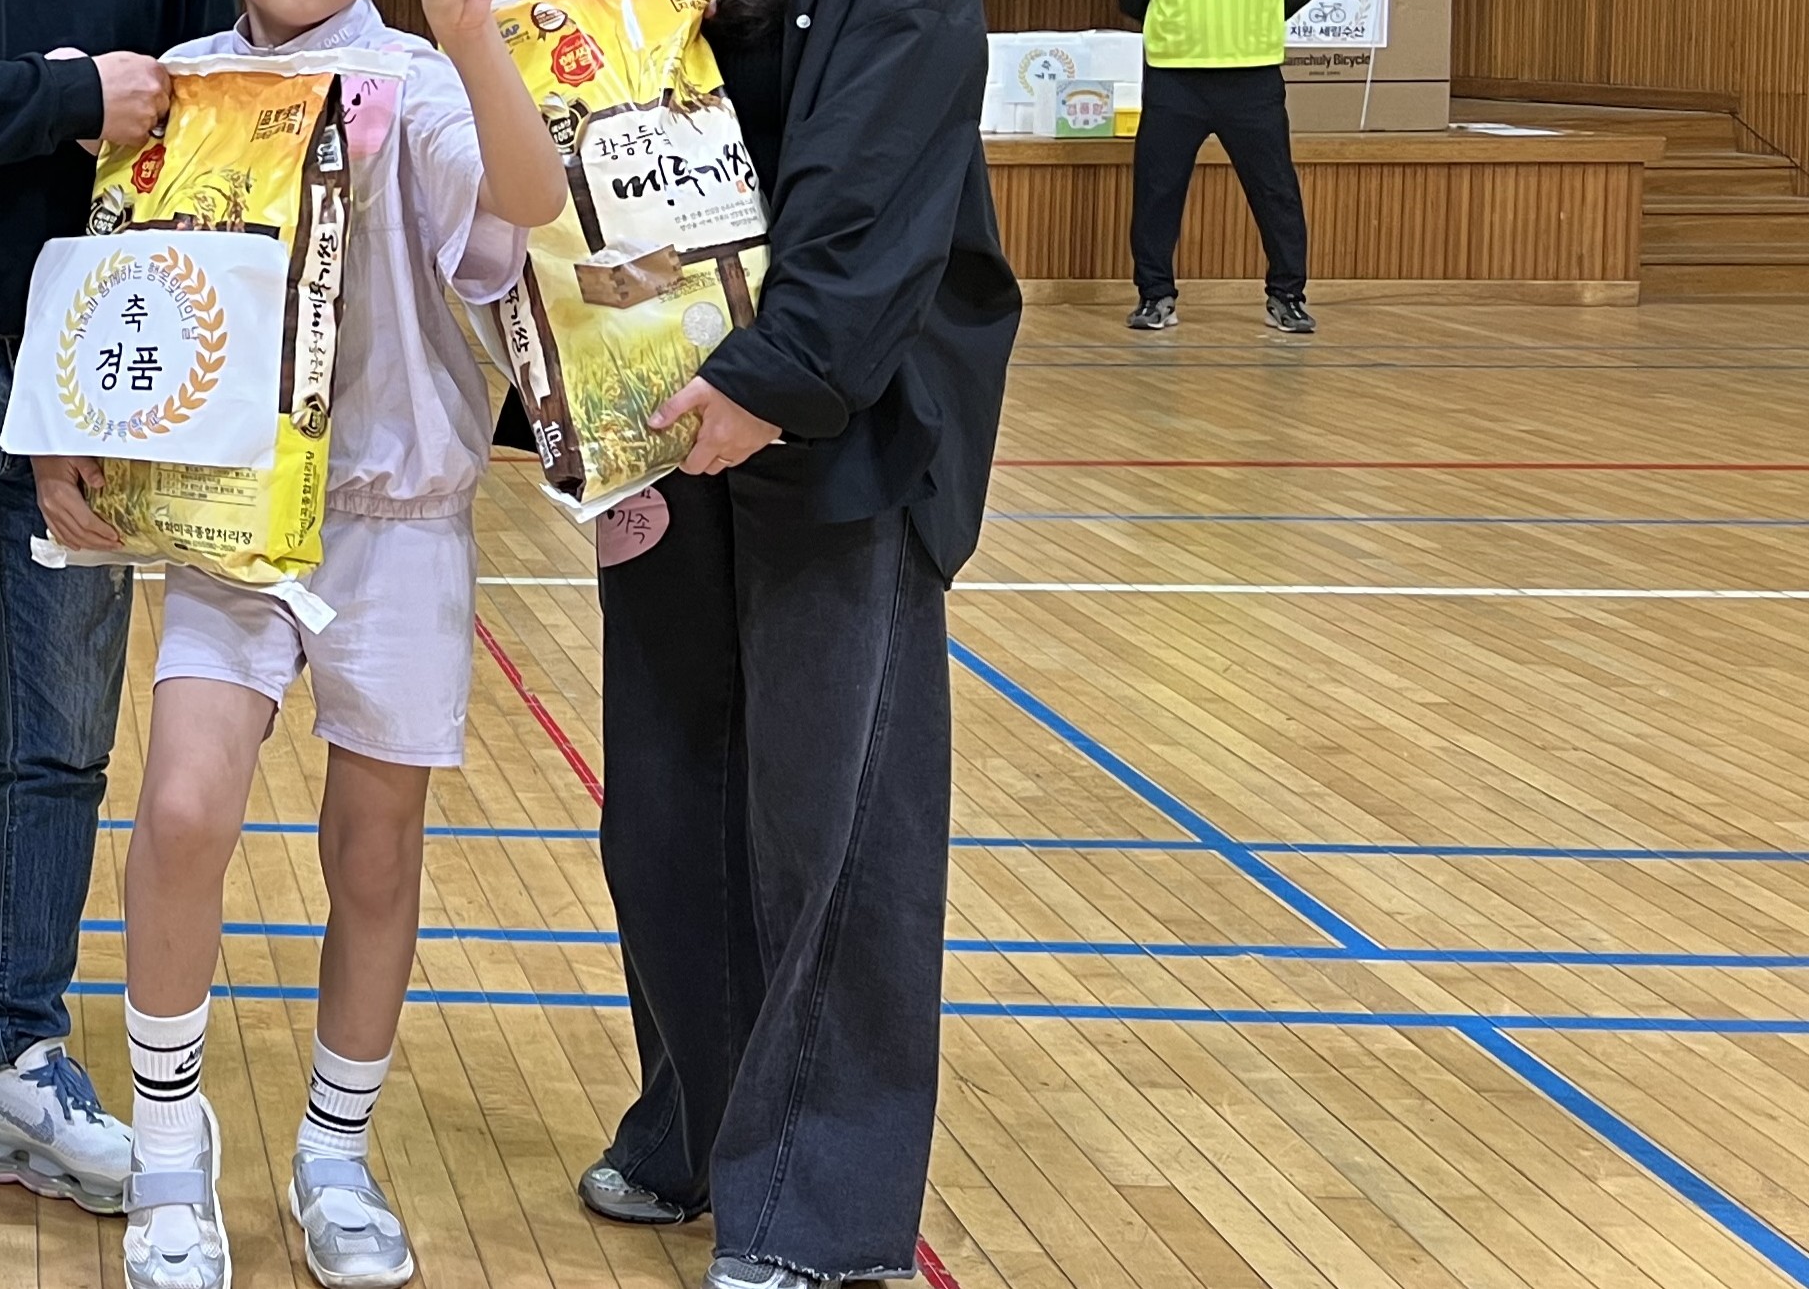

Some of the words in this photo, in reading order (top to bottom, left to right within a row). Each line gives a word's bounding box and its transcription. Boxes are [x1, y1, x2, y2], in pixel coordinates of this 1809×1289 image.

[121, 293, 148, 333] 축
[96, 342, 163, 391] 경품
[617, 510, 652, 544] 가족
